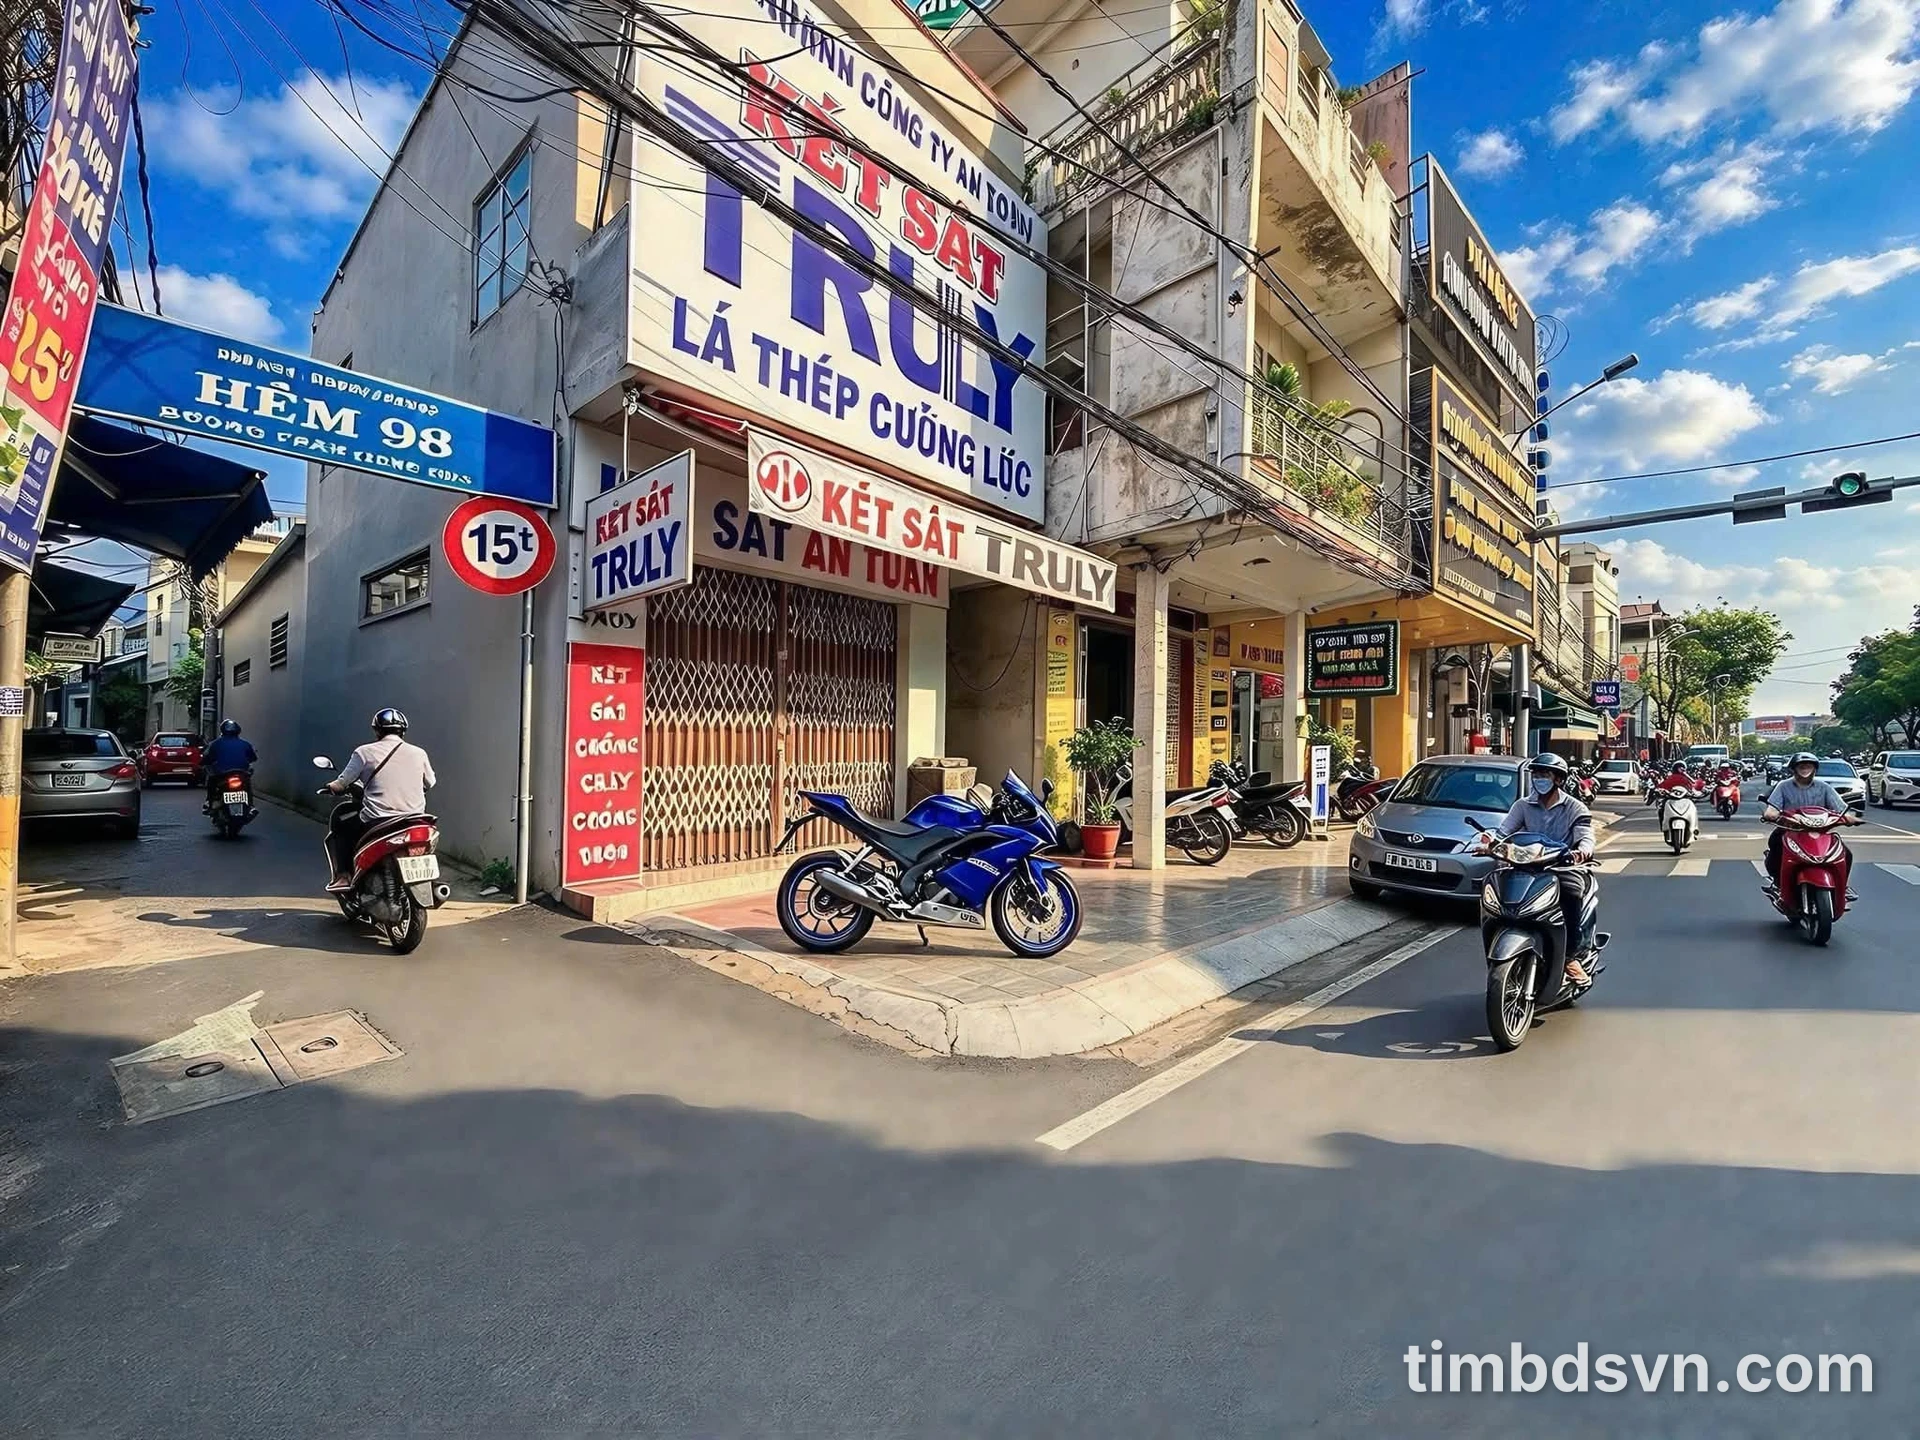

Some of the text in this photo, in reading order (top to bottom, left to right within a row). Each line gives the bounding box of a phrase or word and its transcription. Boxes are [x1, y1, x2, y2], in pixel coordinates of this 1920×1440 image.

[930, 130, 954, 172] TY
[956, 157, 981, 201] AN
[665, 84, 1035, 434] TRULY
[673, 296, 736, 373] LÁ
[752, 332, 860, 421] THÉP
[380, 417, 453, 459] 98
[592, 521, 681, 600] TRULY
[975, 526, 1113, 602] TRULY
